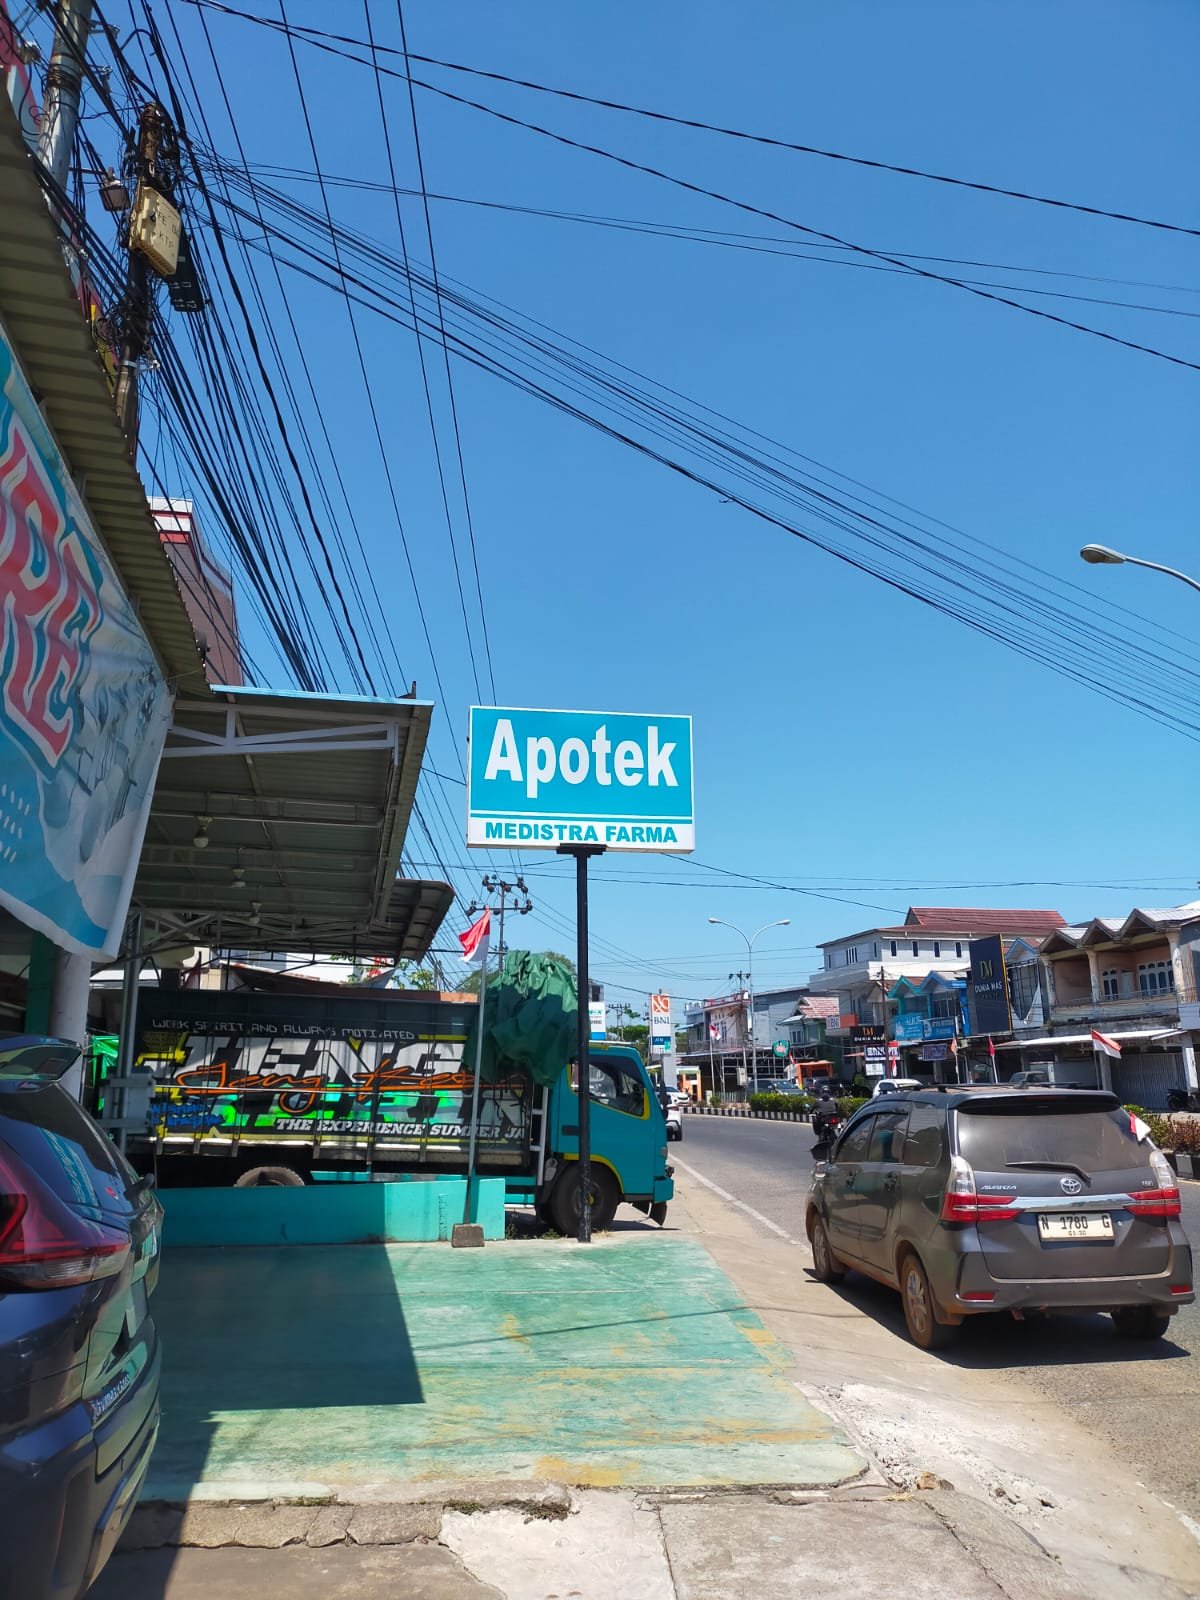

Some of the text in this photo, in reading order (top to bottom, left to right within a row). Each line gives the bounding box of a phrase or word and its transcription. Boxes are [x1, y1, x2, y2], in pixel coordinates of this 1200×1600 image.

[484, 719, 679, 799] Apotek
[485, 822, 677, 843] MEDISTRA FARMA
[251, 1023, 278, 1033] AND
[654, 1016, 670, 1025] BNI
[276, 1118, 313, 1131] THE
[317, 1119, 425, 1135] EXPERIENCE
[429, 1124, 500, 1138] SUMER
[1041, 1215, 1110, 1230] N 1780 G
